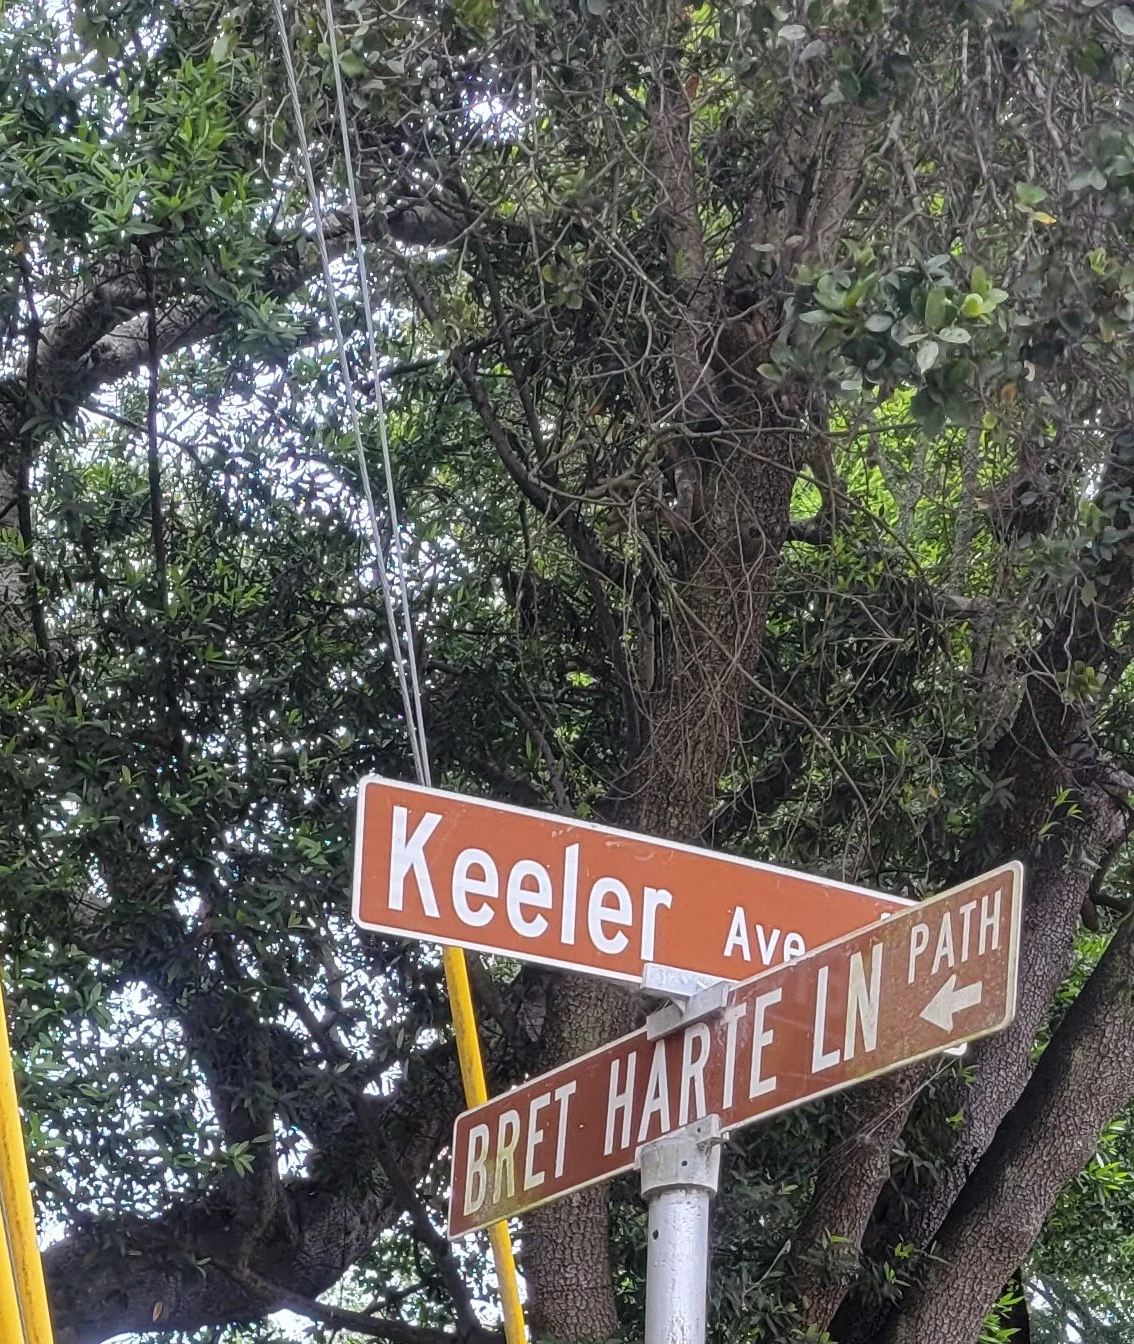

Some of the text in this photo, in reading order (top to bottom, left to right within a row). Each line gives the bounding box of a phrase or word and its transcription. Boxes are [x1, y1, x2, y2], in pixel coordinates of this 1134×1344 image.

[388, 805, 806, 965] Keeler Ave
[463, 889, 1001, 1216] BRET HARTE LN PATH
